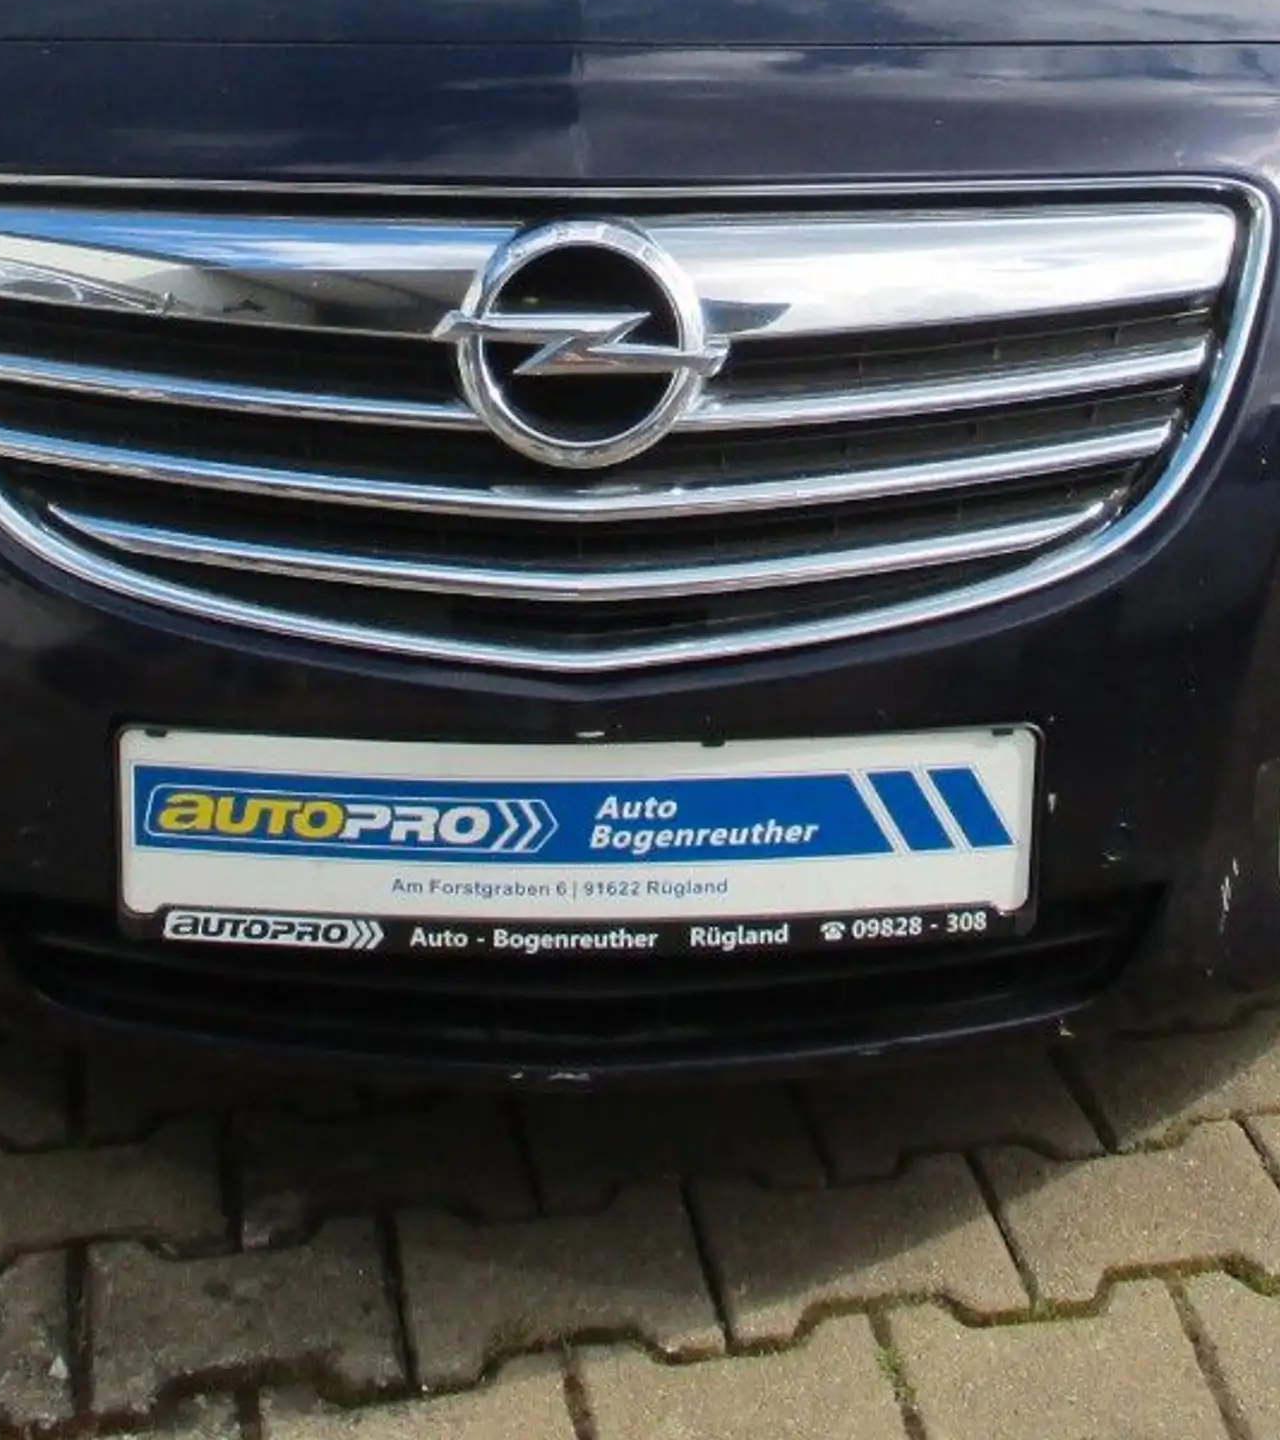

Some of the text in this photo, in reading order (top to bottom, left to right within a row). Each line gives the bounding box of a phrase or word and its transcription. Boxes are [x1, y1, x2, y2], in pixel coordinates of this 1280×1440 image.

[596, 796, 678, 820] Auto
[590, 821, 819, 854] Bogenreuther
[392, 879, 423, 894] Am
[429, 880, 550, 900] Forstgraben
[556, 882, 567, 896] 6
[584, 880, 640, 897] 91622
[646, 878, 729, 901] Rügland
[410, 927, 468, 948] Auto
[493, 929, 658, 955] Bogenreuther
[690, 923, 789, 953] Rügland
[852, 916, 922, 940] 09828
[946, 911, 987, 934] 308
